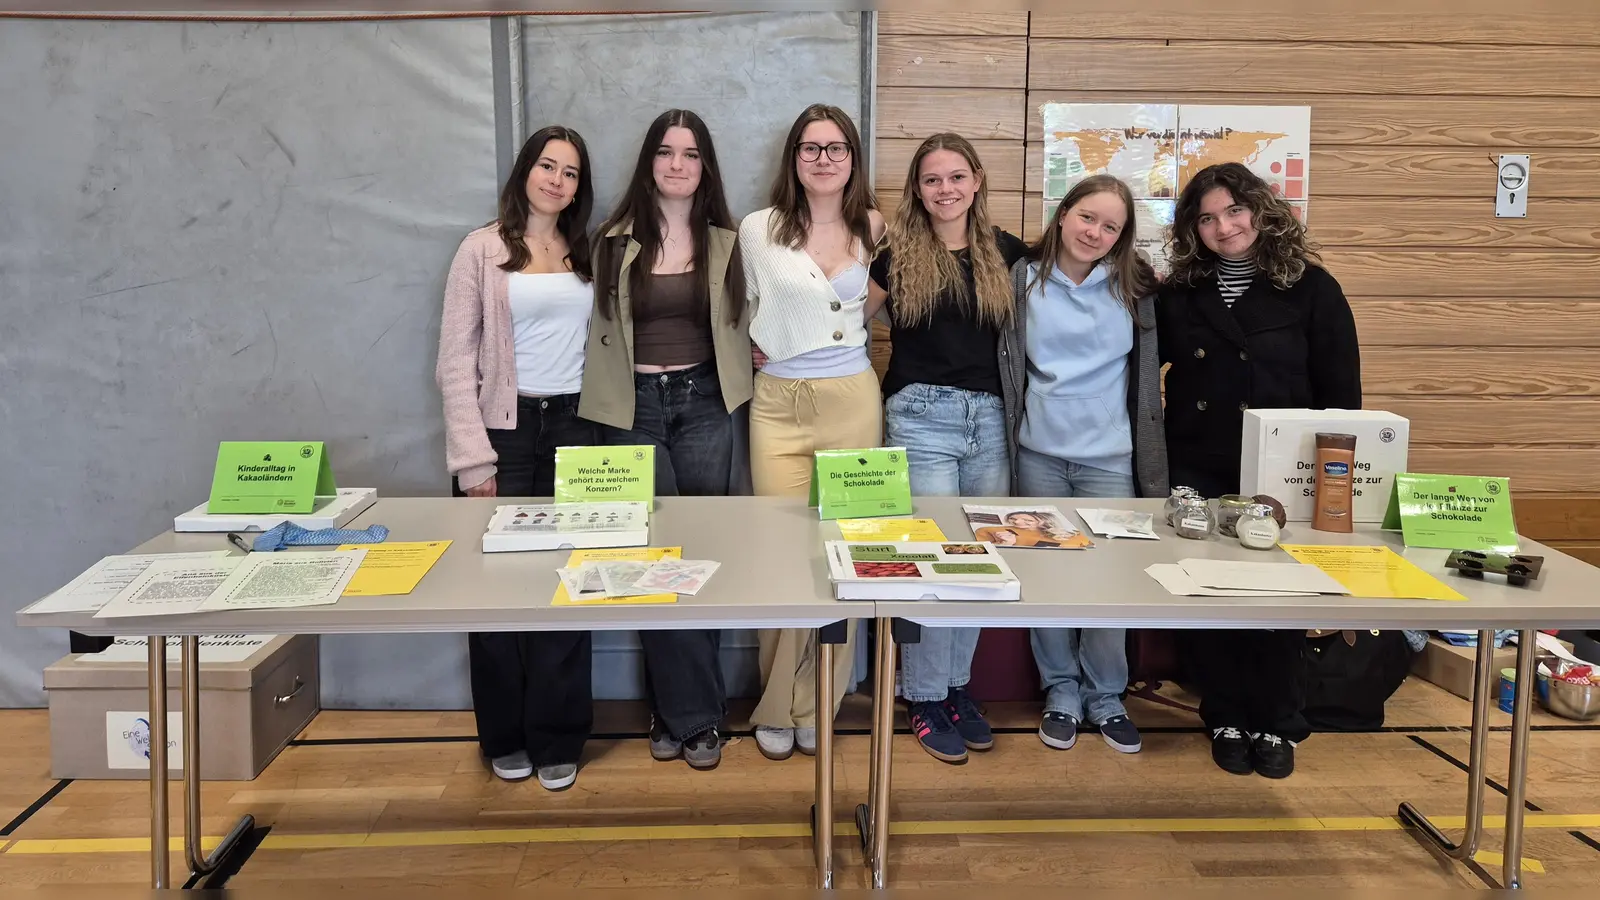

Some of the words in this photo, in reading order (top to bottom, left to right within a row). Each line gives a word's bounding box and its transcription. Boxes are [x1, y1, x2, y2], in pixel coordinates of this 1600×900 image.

[237, 465, 286, 473] Kinderalltag
[1297, 461, 1316, 470] Der
[577, 467, 606, 475] Welche
[568, 477, 593, 485] gehört
[843, 479, 885, 487] Schokolade
[1431, 493, 1455, 502] lange
[1456, 494, 1477, 503] Weg
[1431, 512, 1482, 522] Schokolade
[122, 730, 140, 740] Eine
